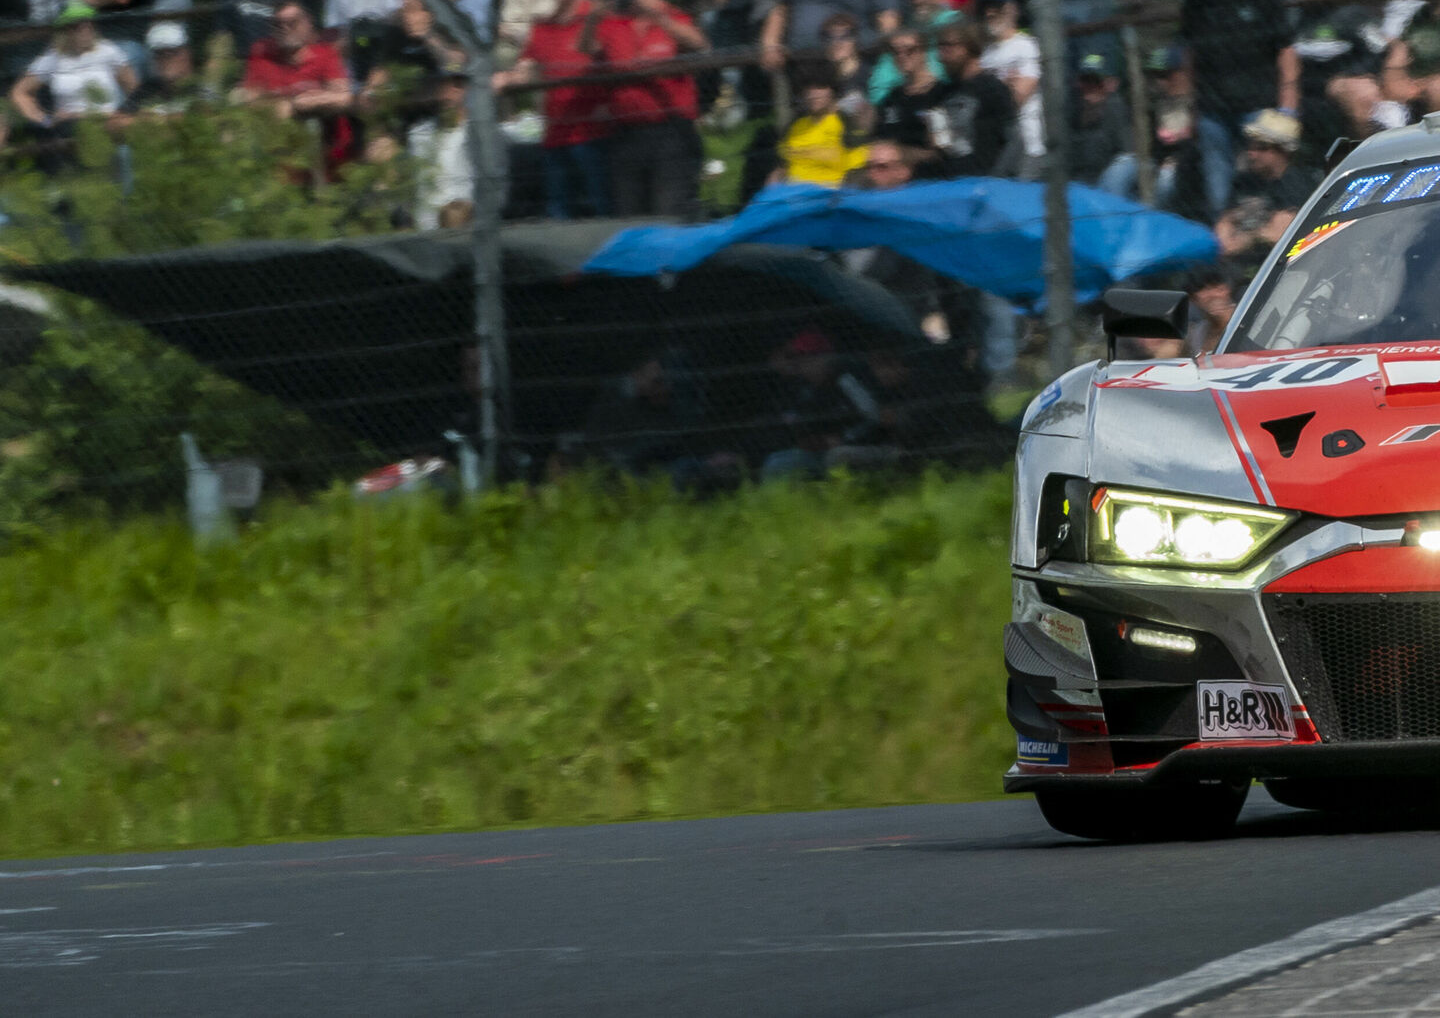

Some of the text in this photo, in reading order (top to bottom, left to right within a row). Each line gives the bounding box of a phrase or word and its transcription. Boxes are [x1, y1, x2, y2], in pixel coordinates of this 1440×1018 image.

[1210, 357, 1363, 390] 40
[1201, 690, 1268, 731] H&R
[1019, 741, 1059, 755] MICHELIN
